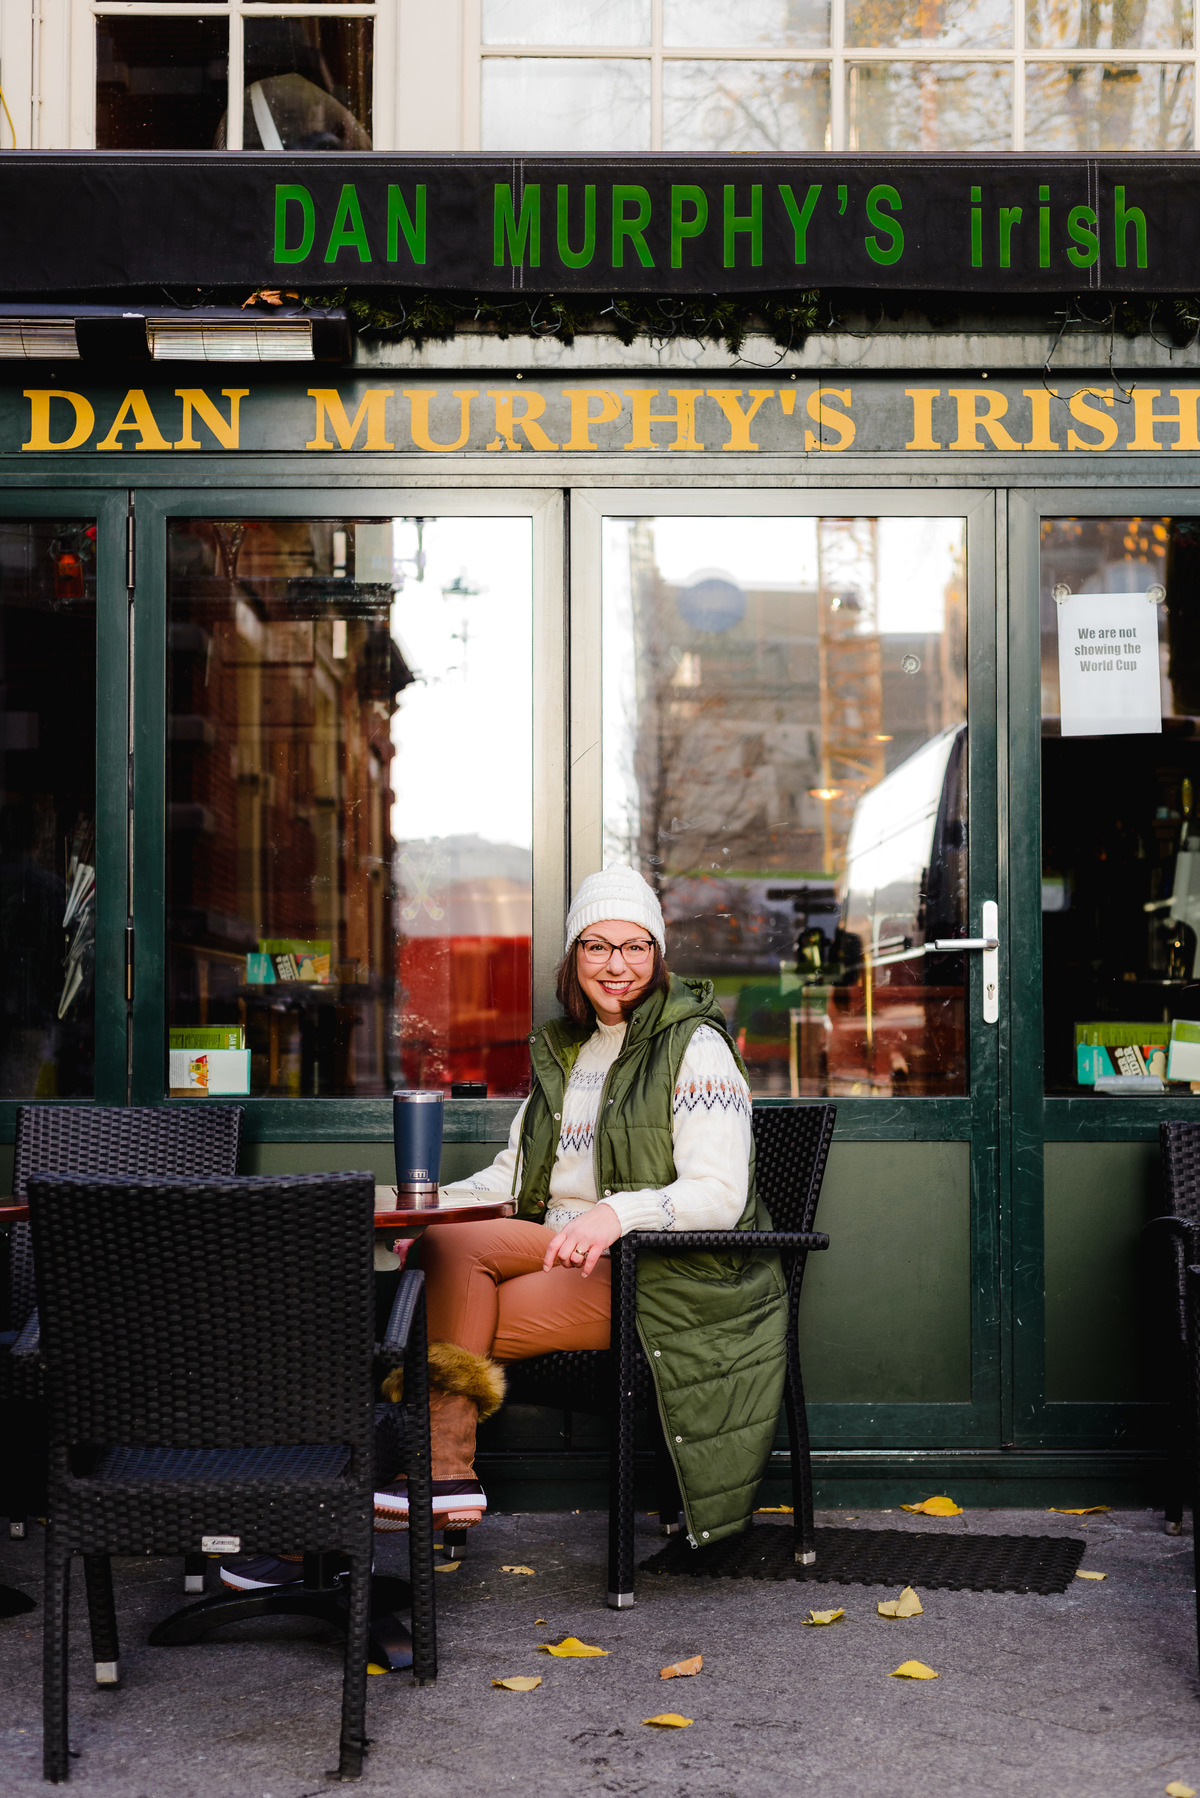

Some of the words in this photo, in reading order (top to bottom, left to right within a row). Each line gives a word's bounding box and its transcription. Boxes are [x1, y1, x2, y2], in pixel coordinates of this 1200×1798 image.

[273, 183, 427, 265] DAN
[493, 183, 905, 269] MURPHY'S
[970, 185, 1148, 269] irish
[21, 388, 250, 451] DAN
[305, 387, 857, 452] MURPHY'S
[904, 387, 1200, 451] IRISH
[1077, 628, 1096, 640] We
[1098, 628, 1117, 639] are
[1118, 627, 1137, 638] not
[1074, 643, 1121, 656] showing
[1123, 643, 1141, 654] the
[1079, 659, 1114, 672] World
[1115, 659, 1137, 671] Cup
